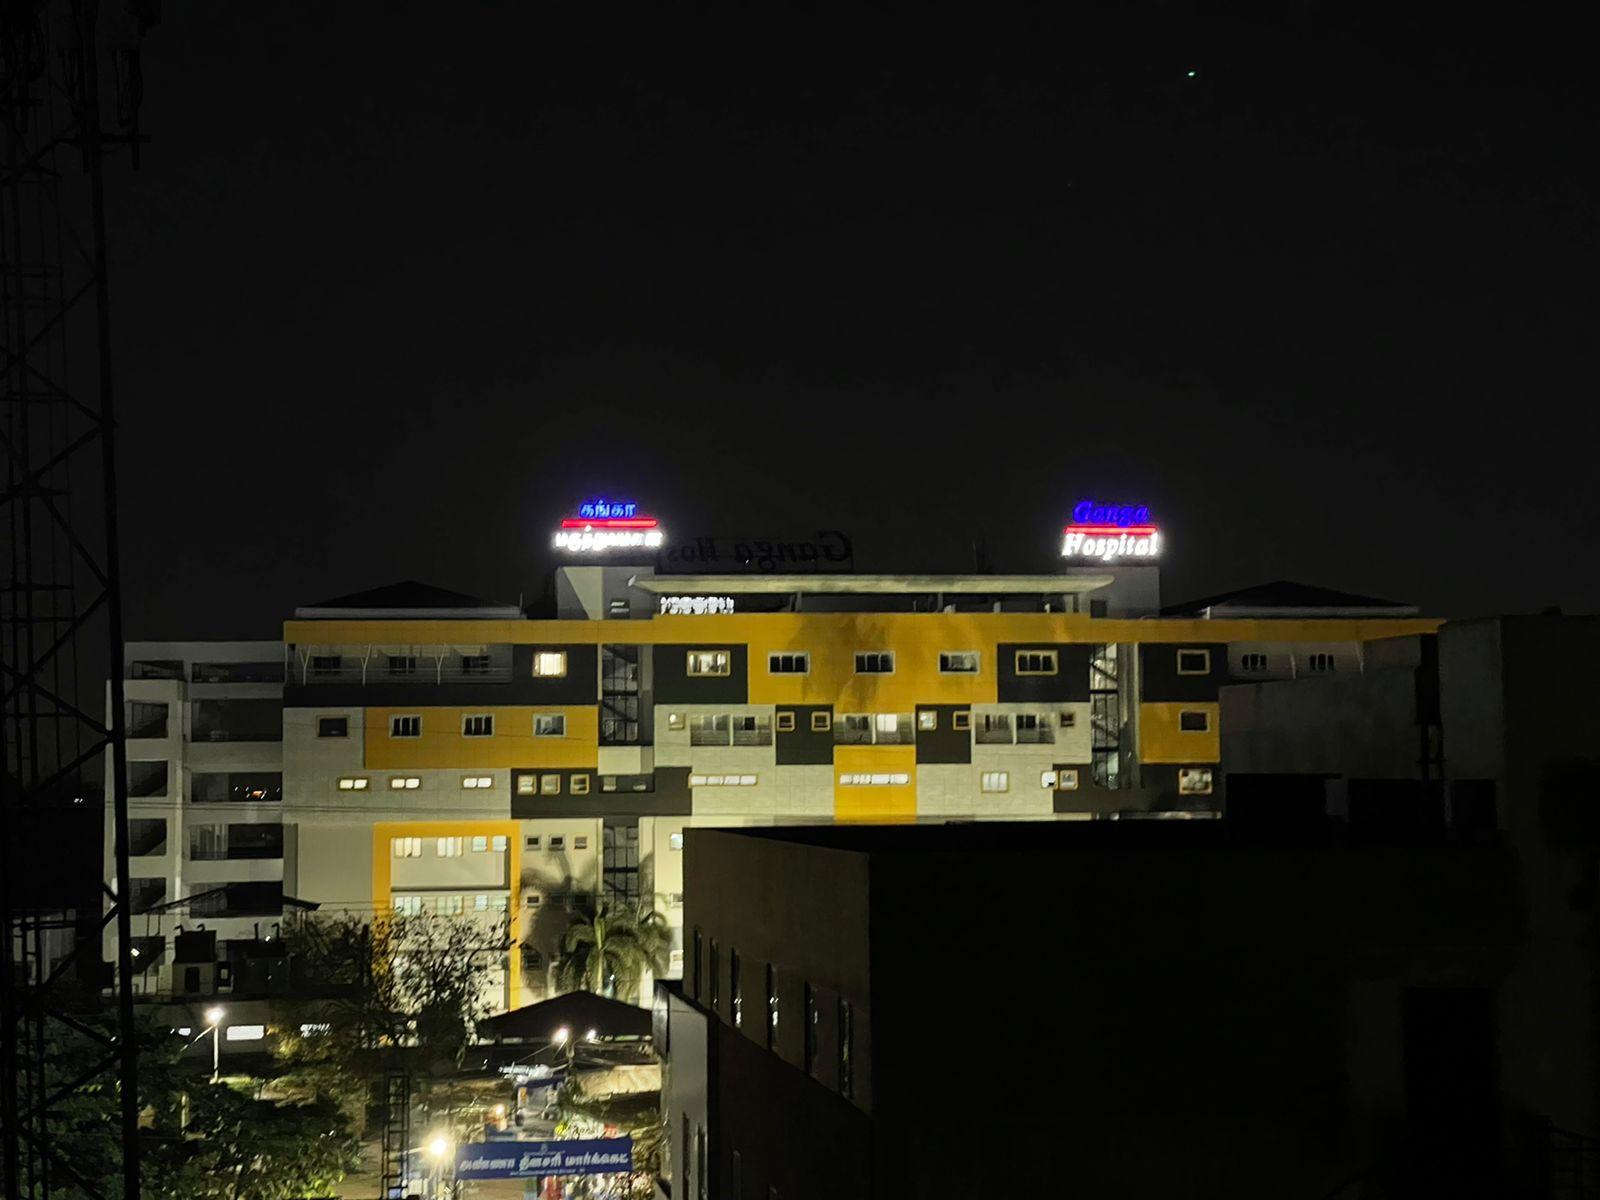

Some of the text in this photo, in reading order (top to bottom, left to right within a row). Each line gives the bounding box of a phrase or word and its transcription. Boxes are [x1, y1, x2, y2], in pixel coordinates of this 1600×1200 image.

[580, 499, 636, 518] கங்கா
[1073, 500, 1150, 527] Ganga
[1061, 532, 1159, 561] Hospital
